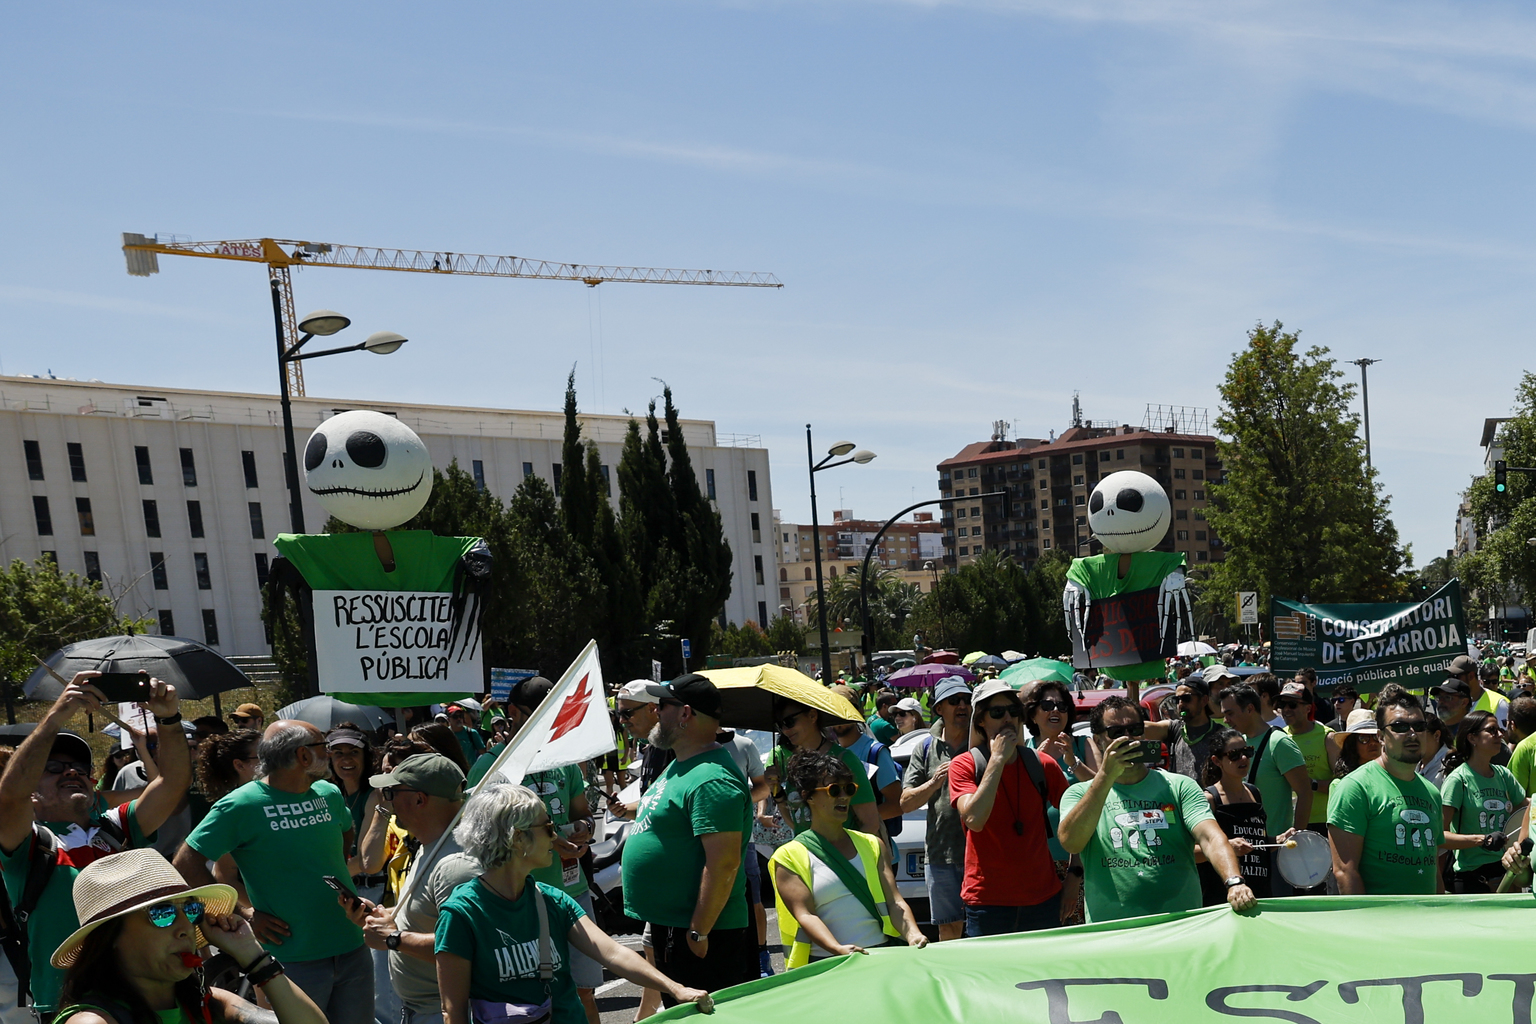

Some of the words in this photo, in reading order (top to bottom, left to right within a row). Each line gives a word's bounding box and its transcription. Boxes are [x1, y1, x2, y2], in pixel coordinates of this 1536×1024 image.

[356, 625, 448, 651] L'ESCOLA
[1322, 641, 1346, 664] DE
[1352, 623, 1462, 663] CATARROJA
[360, 651, 448, 681] PÚBLICA
[1356, 666, 1397, 685] pública
[1400, 665, 1403, 677] i
[1405, 664, 1420, 677] de
[1422, 658, 1453, 675] qualit
[270, 808, 333, 831] educació
[1233, 825, 1266, 838] EDUCACI
[1101, 857, 1140, 868] L'ESCOLA
[1250, 854, 1261, 863] DE
[1378, 850, 1421, 866] L'ESCOLA
[494, 946, 516, 978] LA
